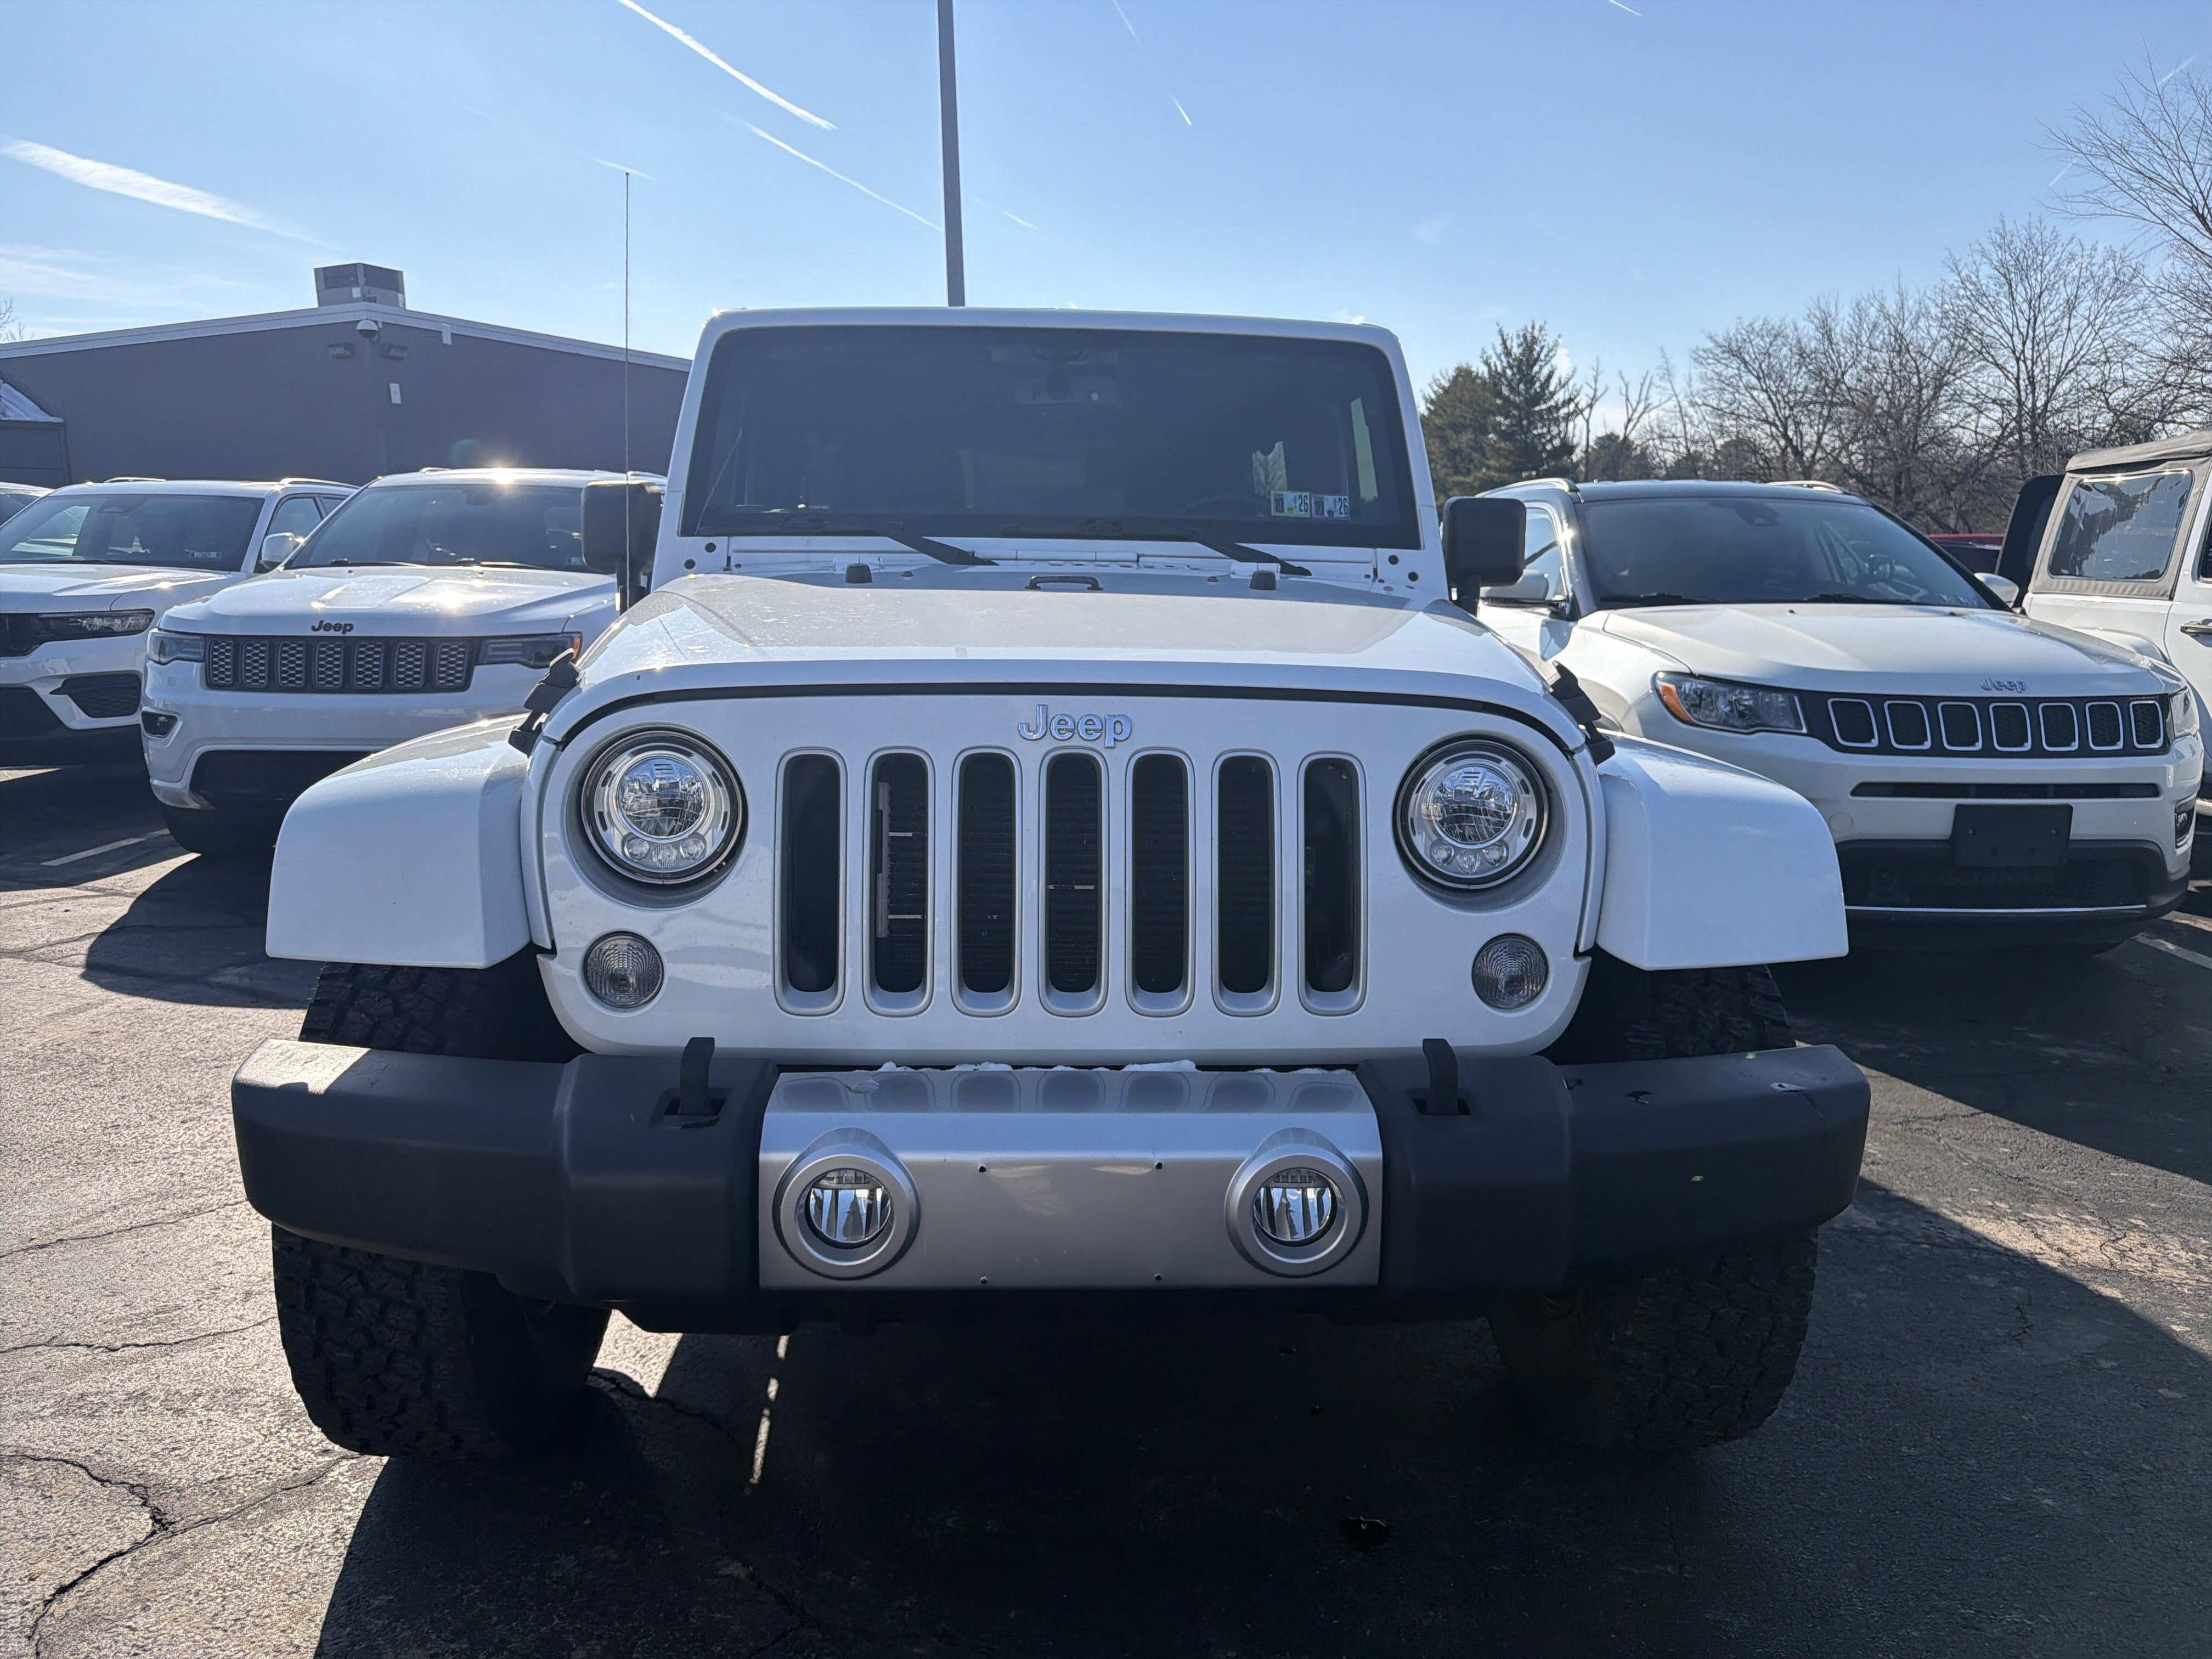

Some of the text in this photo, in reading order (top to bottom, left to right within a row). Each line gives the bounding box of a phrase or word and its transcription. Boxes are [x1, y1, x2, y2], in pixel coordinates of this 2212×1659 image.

[1298, 494, 1308, 513] 26
[1338, 497, 1348, 515] 26
[311, 619, 354, 635] Jeep
[1980, 676, 2027, 693] Jeep
[1018, 704, 1132, 749] Jeep
